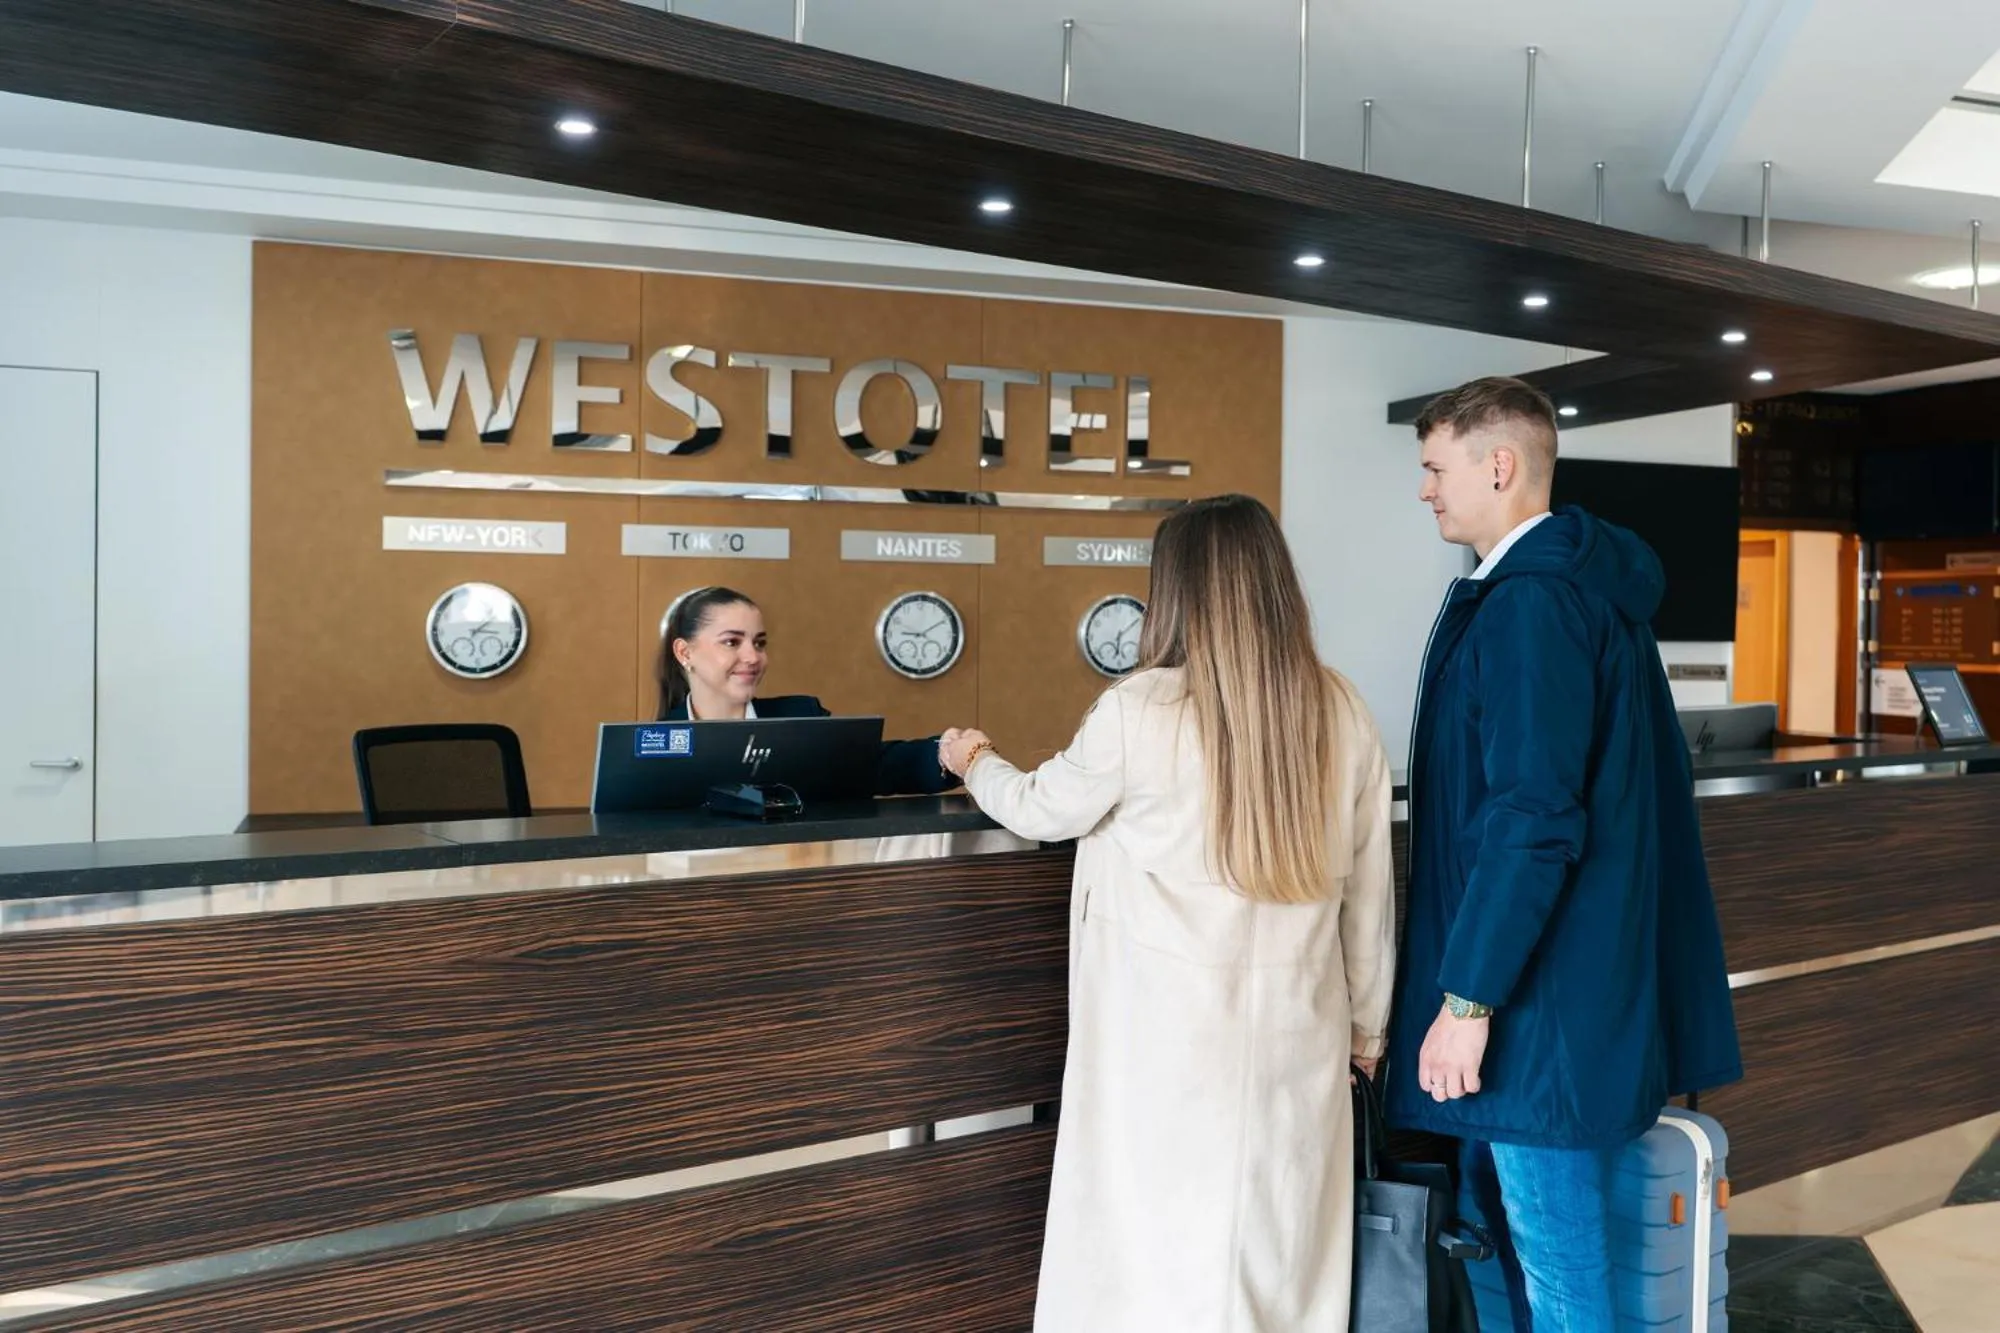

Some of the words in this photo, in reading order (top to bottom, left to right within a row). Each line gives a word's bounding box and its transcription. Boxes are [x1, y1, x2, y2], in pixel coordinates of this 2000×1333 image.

[388, 328, 1191, 477] WESTOTEL
[407, 523, 544, 548] NEW-YORK
[876, 536, 963, 558] NANTES
[1076, 542, 1152, 562] SYDNE
[1695, 720, 1717, 753] hp
[741, 734, 772, 777] hp
